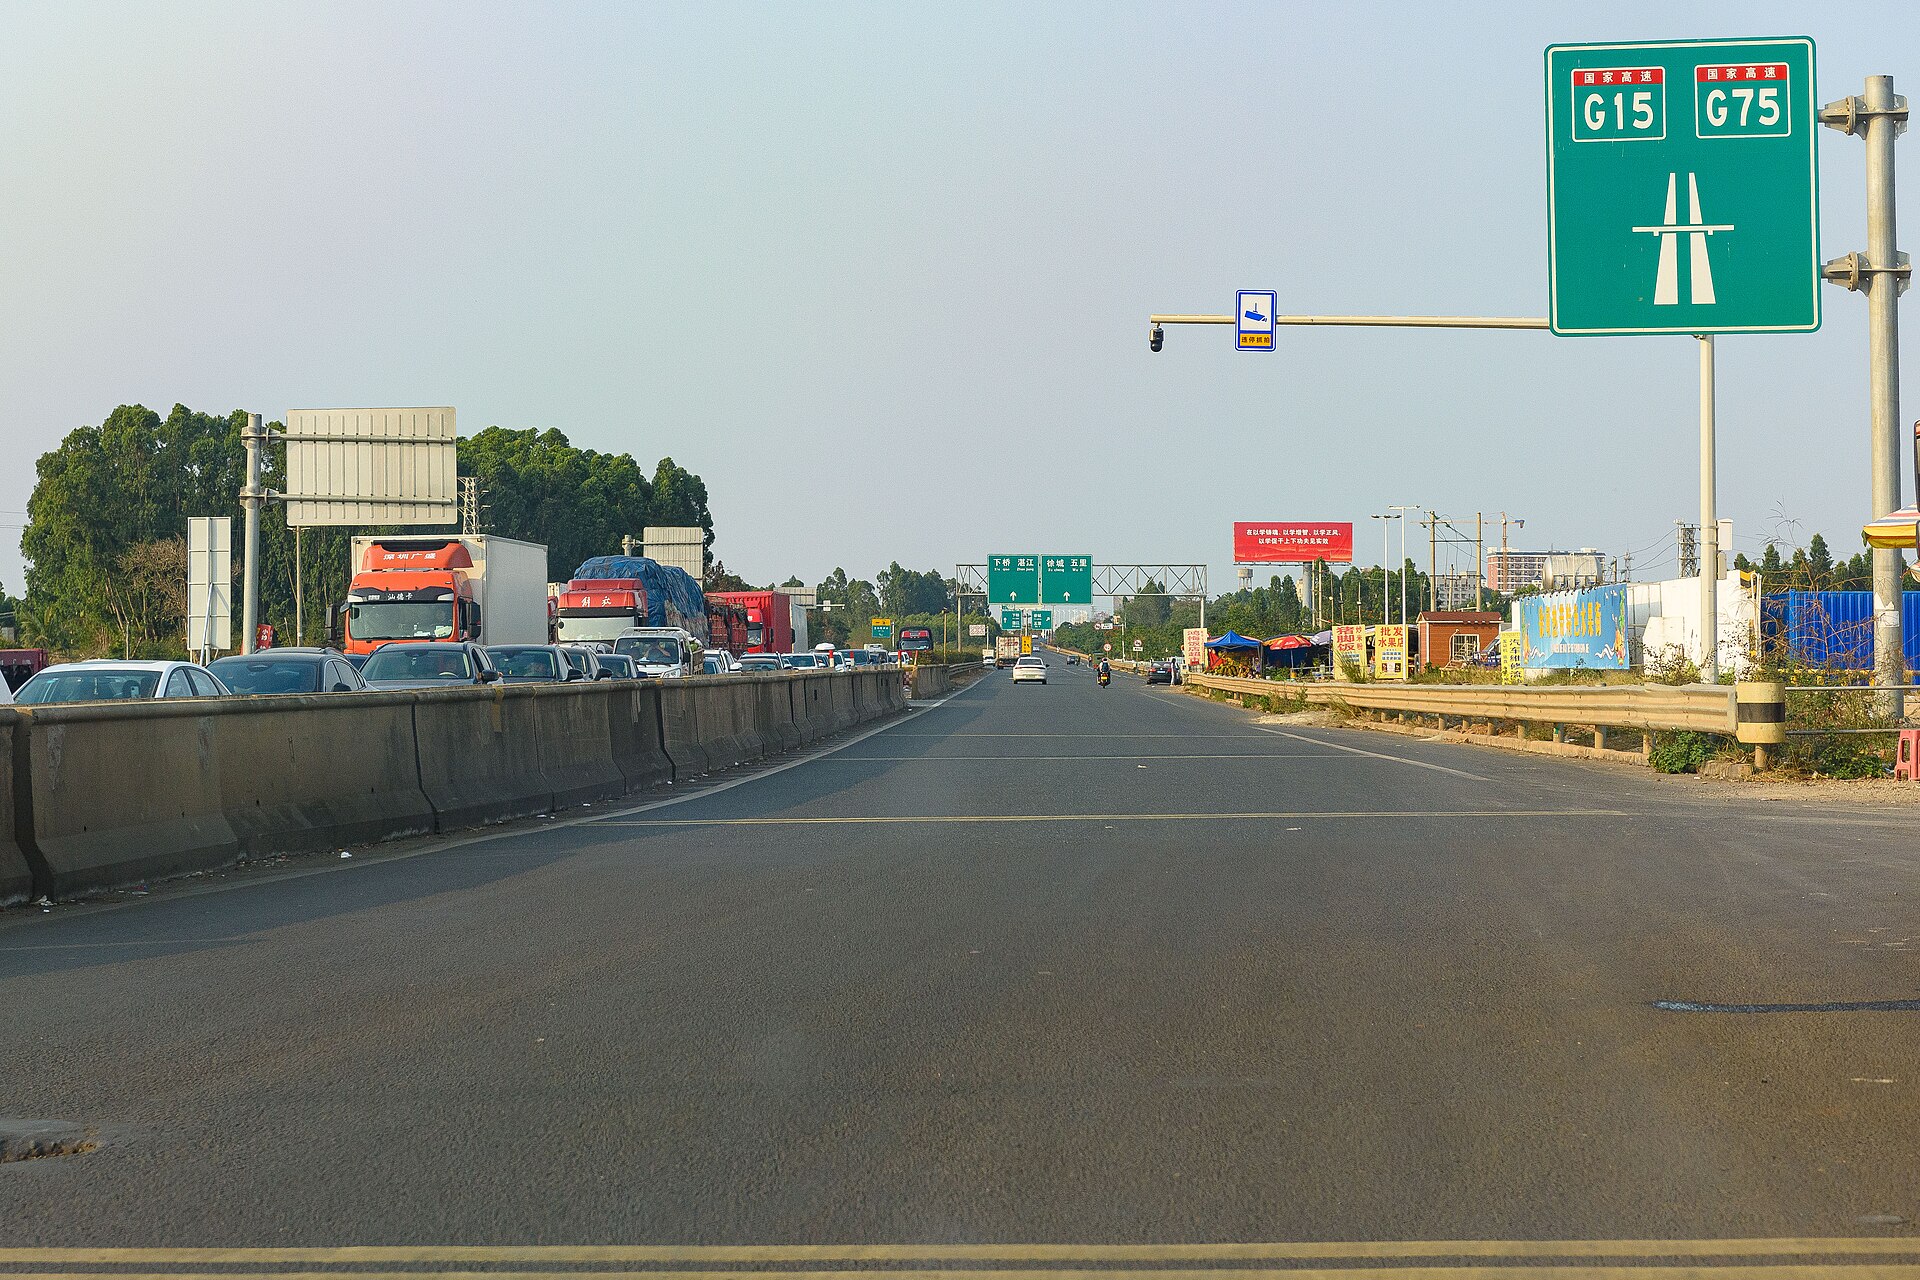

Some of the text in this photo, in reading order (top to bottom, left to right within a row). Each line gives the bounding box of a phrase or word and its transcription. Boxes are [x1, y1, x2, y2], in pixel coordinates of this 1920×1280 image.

[1584, 71, 1652, 84] 国家高速
[1707, 66, 1777, 80] 国家高速
[1584, 92, 1654, 131] G15
[1706, 88, 1780, 127] G75
[383, 552, 437, 560] 深圳广盛
[993, 558, 1035, 567] 下桥 湛江
[1070, 558, 1088, 567] 五里
[387, 592, 413, 601] 汕德卡
[581, 595, 612, 608] 解放
[1380, 626, 1404, 637] 批发
[1336, 626, 1356, 652] 猪脚饭
[1355, 626, 1363, 651] 炒米粉
[1377, 637, 1404, 648] 水果店
